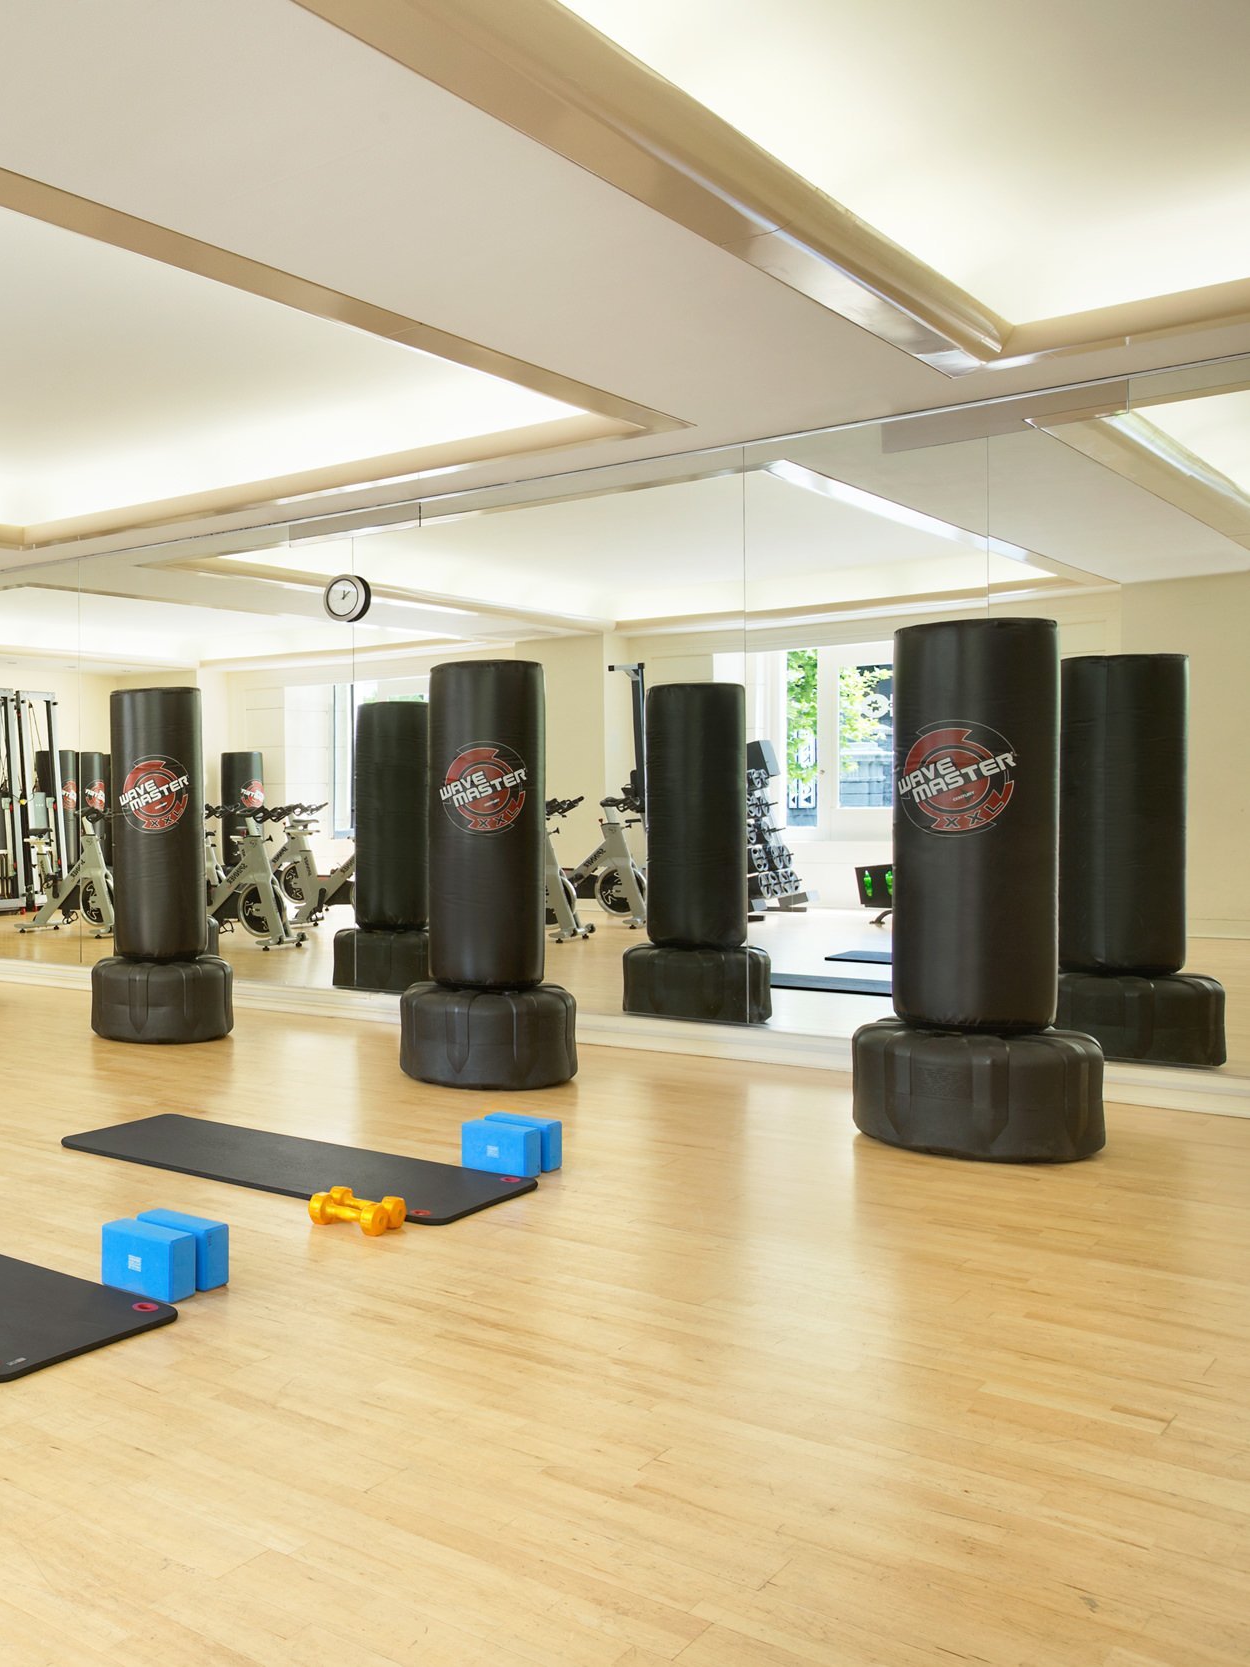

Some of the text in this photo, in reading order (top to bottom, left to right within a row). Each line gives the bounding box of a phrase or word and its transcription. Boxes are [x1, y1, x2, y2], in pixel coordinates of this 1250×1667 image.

[439, 771, 487, 801] WAVE
[452, 769, 527, 807] MASTER
[898, 757, 956, 796] WAVE
[912, 752, 1017, 803] MASTER
[119, 780, 157, 806] WAVE
[130, 775, 189, 811] MASTER
[150, 807, 184, 828] XXL
[477, 807, 519, 829] XXL
[943, 801, 1004, 829] XXL
